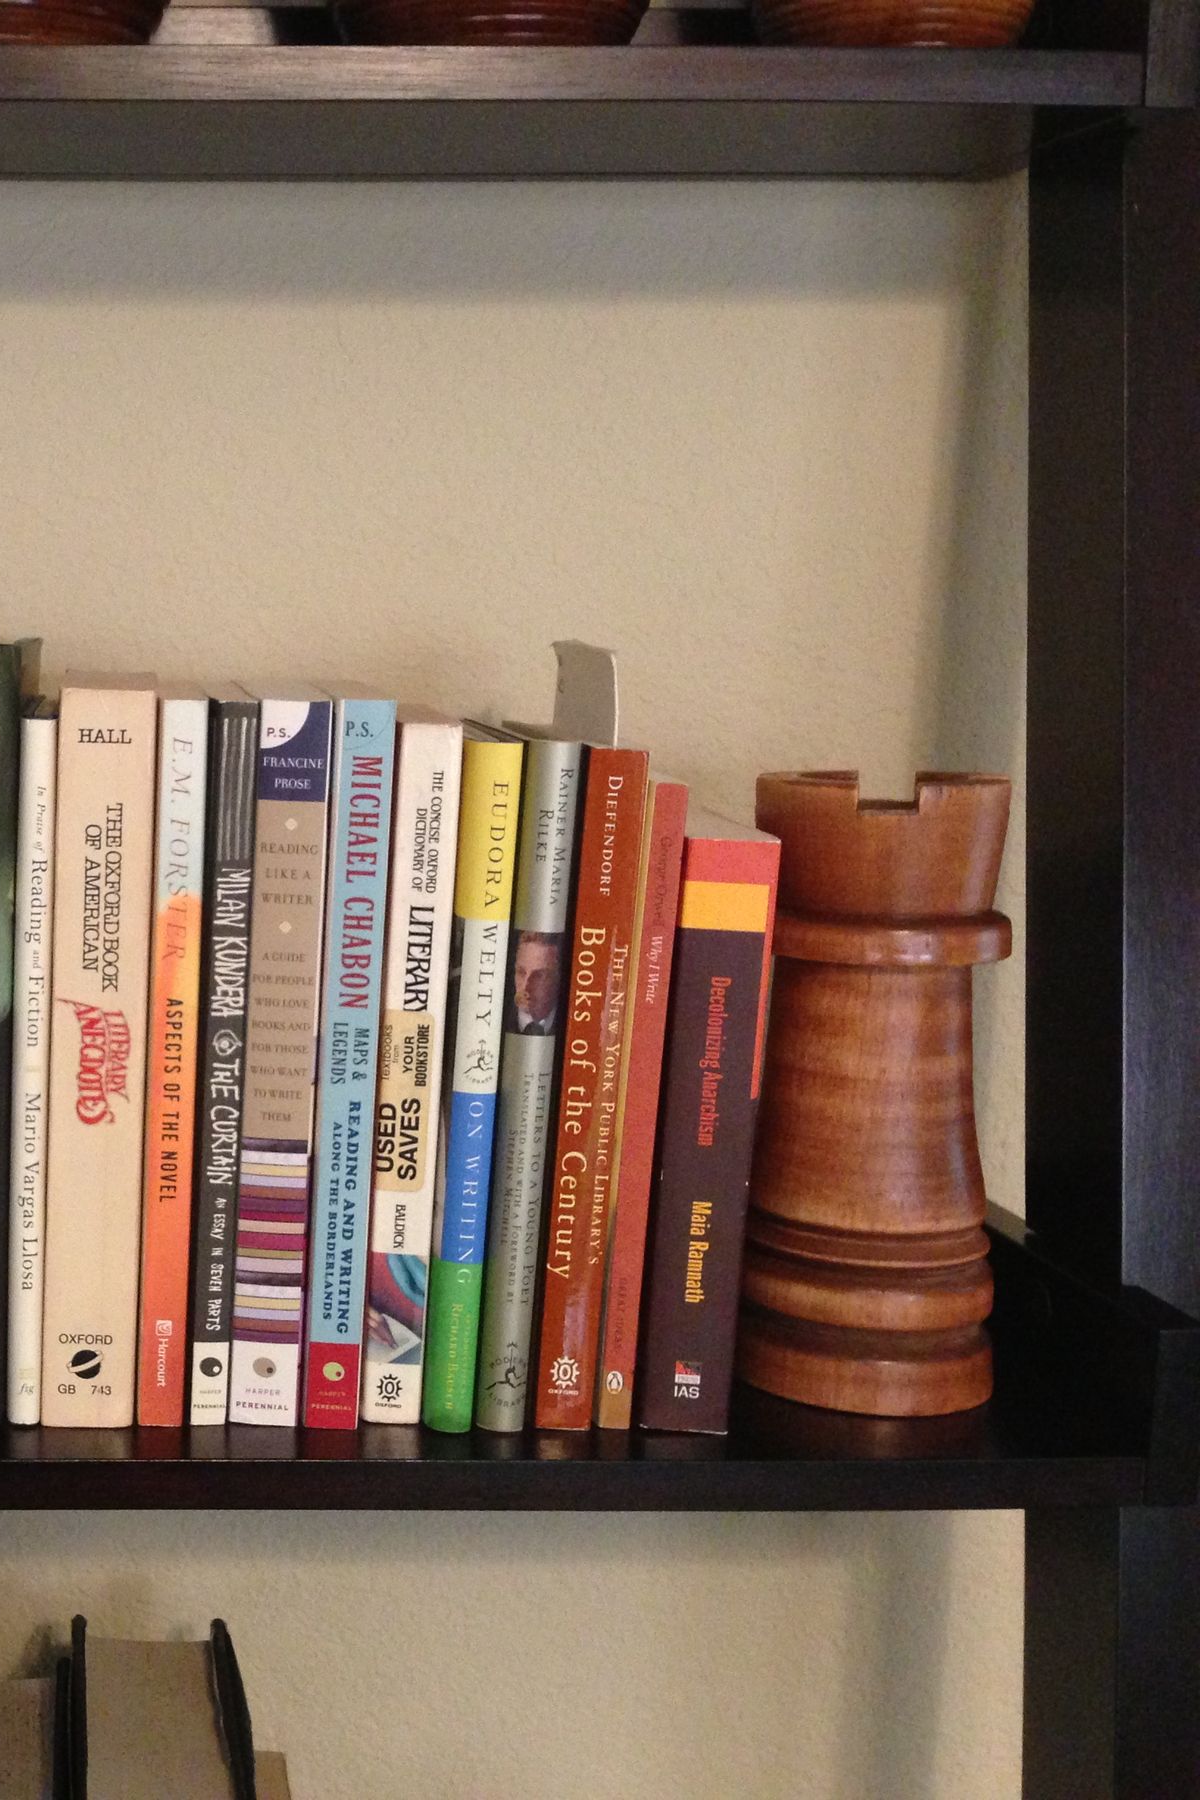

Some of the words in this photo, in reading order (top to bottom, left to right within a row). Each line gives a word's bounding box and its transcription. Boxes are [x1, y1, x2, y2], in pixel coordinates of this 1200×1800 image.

[78, 729, 132, 744] HALL
[267, 728, 291, 738] P.S.
[263, 757, 324, 769] FRANCINE
[274, 778, 311, 789] PROSE
[36, 803, 47, 836] Praise
[106, 803, 123, 847] THE
[345, 756, 383, 884] MICHAEL
[428, 796, 443, 844] CONCISE
[556, 768, 574, 838] RAINER
[85, 824, 102, 850] OF
[412, 808, 428, 874] DICTIONARY
[484, 782, 509, 908] EUDORA
[535, 809, 554, 863] RILKE
[599, 775, 624, 896] DIEFENDORF
[103, 851, 122, 935] OXFORD
[266, 868, 297, 879] LIKE
[303, 871, 311, 879] A
[425, 850, 439, 894] OXFORD
[25, 860, 47, 943] Reading
[83, 859, 101, 972] AMERICAN
[213, 868, 251, 928] MILAN
[102, 937, 120, 992] BOOK
[211, 937, 248, 1017] KUNDERA
[271, 953, 306, 962] GUIDE
[339, 897, 375, 1009] CHABON
[476, 924, 498, 1025] WELTY
[573, 926, 606, 1022] Books
[275, 976, 313, 985] PEOPLE
[164, 998, 183, 1074] ASPECTS
[353, 1028, 370, 1067] MAPS
[700, 976, 732, 1069] Decolonizing
[331, 1022, 349, 1085] LEGENDS
[352, 1071, 367, 1081] &
[402, 1036, 415, 1074] YOUR
[414, 1024, 430, 1087] BOOKSTORE
[570, 1039, 596, 1073] of
[602, 1044, 621, 1092] YORK
[163, 1083, 181, 1102] OF
[210, 1058, 240, 1101] THE
[24, 1093, 41, 1153] Mario
[161, 1112, 179, 1142] THE
[261, 1112, 291, 1121] THEM
[467, 1101, 484, 1140] ON
[565, 1085, 592, 1135] the
[698, 1072, 724, 1147] Anarchism
[345, 1101, 362, 1190] READING
[376, 1103, 397, 1172] USED
[397, 1098, 421, 1180] SAVES
[597, 1102, 615, 1168] PUBLIC
[159, 1151, 177, 1203] NOVEL
[531, 1152, 541, 1172] TO
[18, 1161, 40, 1229] Vargas
[327, 1179, 339, 1206] THE
[548, 1151, 587, 1279] Century
[342, 1201, 355, 1240] AND
[456, 1155, 481, 1285] WRITING
[690, 1201, 713, 1236] Maia
[211, 1248, 223, 1256] IN
[323, 1212, 338, 1320] BORDERLANDS
[685, 1241, 710, 1303] Ramnath
[337, 1248, 353, 1334] WRITING
[58, 1333, 113, 1345] OXFORD
[57, 1383, 77, 1395] GB
[236, 1401, 289, 1411] PERENNIAL
[245, 1388, 281, 1396] HARPER
[674, 1385, 700, 1399] IAS
